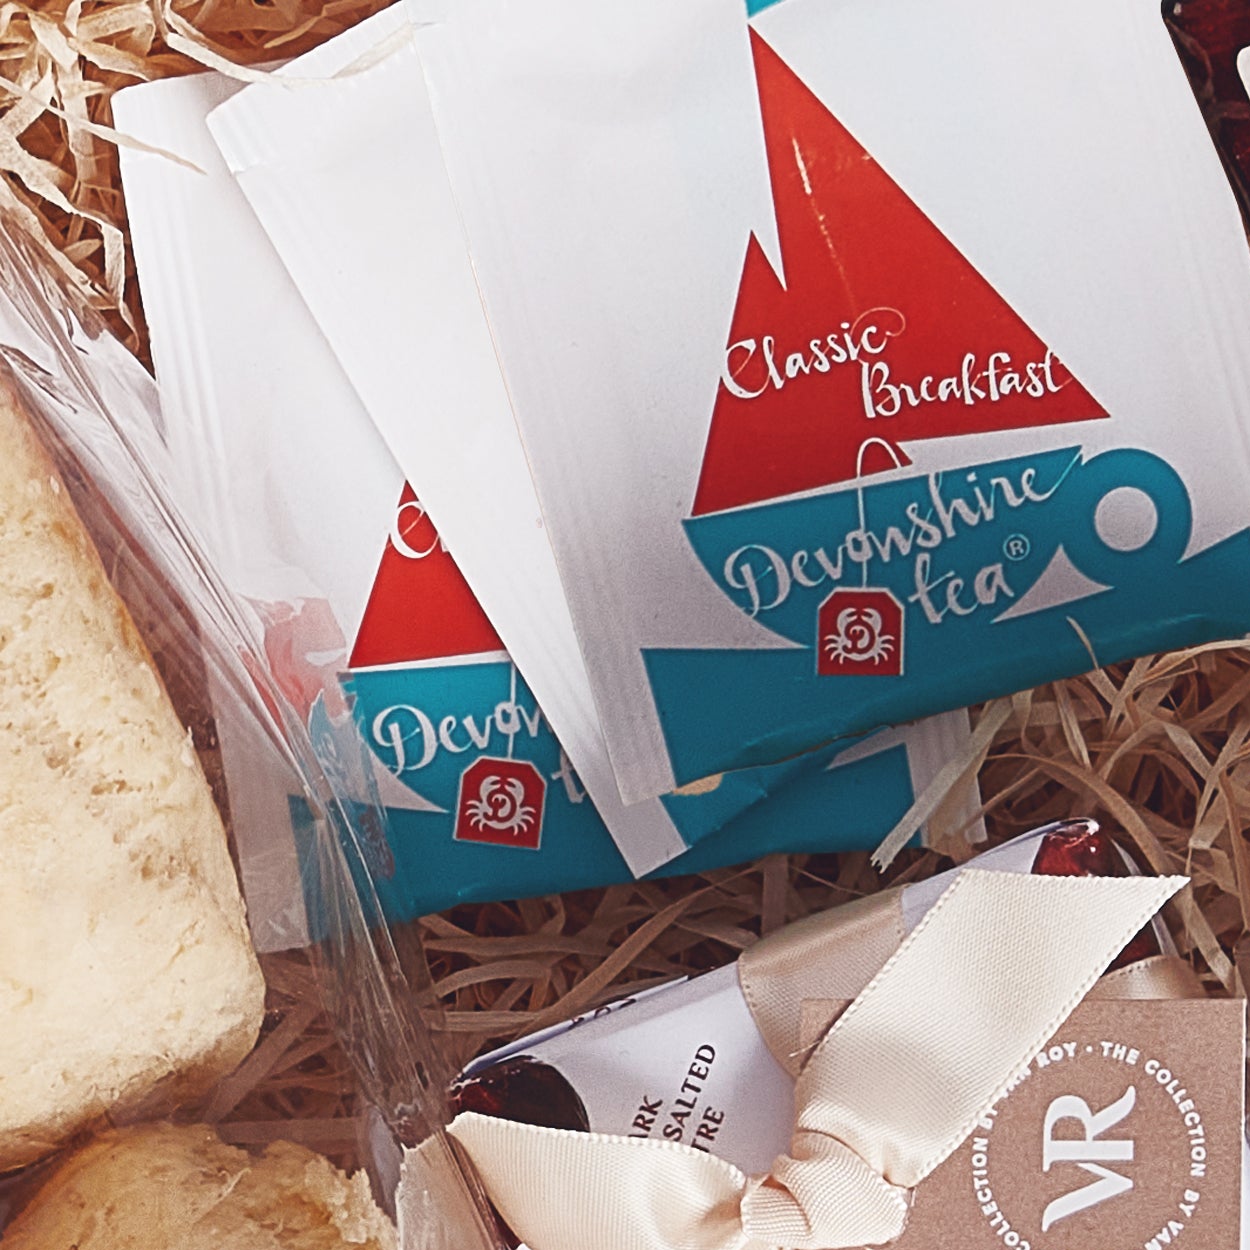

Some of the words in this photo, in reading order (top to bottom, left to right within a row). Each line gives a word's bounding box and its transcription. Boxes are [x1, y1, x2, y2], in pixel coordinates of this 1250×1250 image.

[720, 307, 905, 399] Classic
[861, 346, 1072, 418] Breakfast
[725, 455, 1082, 617] Devonshire
[372, 701, 553, 776] Devon
[663, 1045, 716, 1142] SALTED
[1036, 1042, 1077, 1068] ROY
[628, 1095, 663, 1138] RK
[691, 1106, 724, 1153] TRE
[1101, 1041, 1140, 1065] THE
[1145, 1059, 1206, 1177] COLLECTION
[1179, 1189, 1200, 1218] BY
[1042, 1085, 1136, 1232] VR
